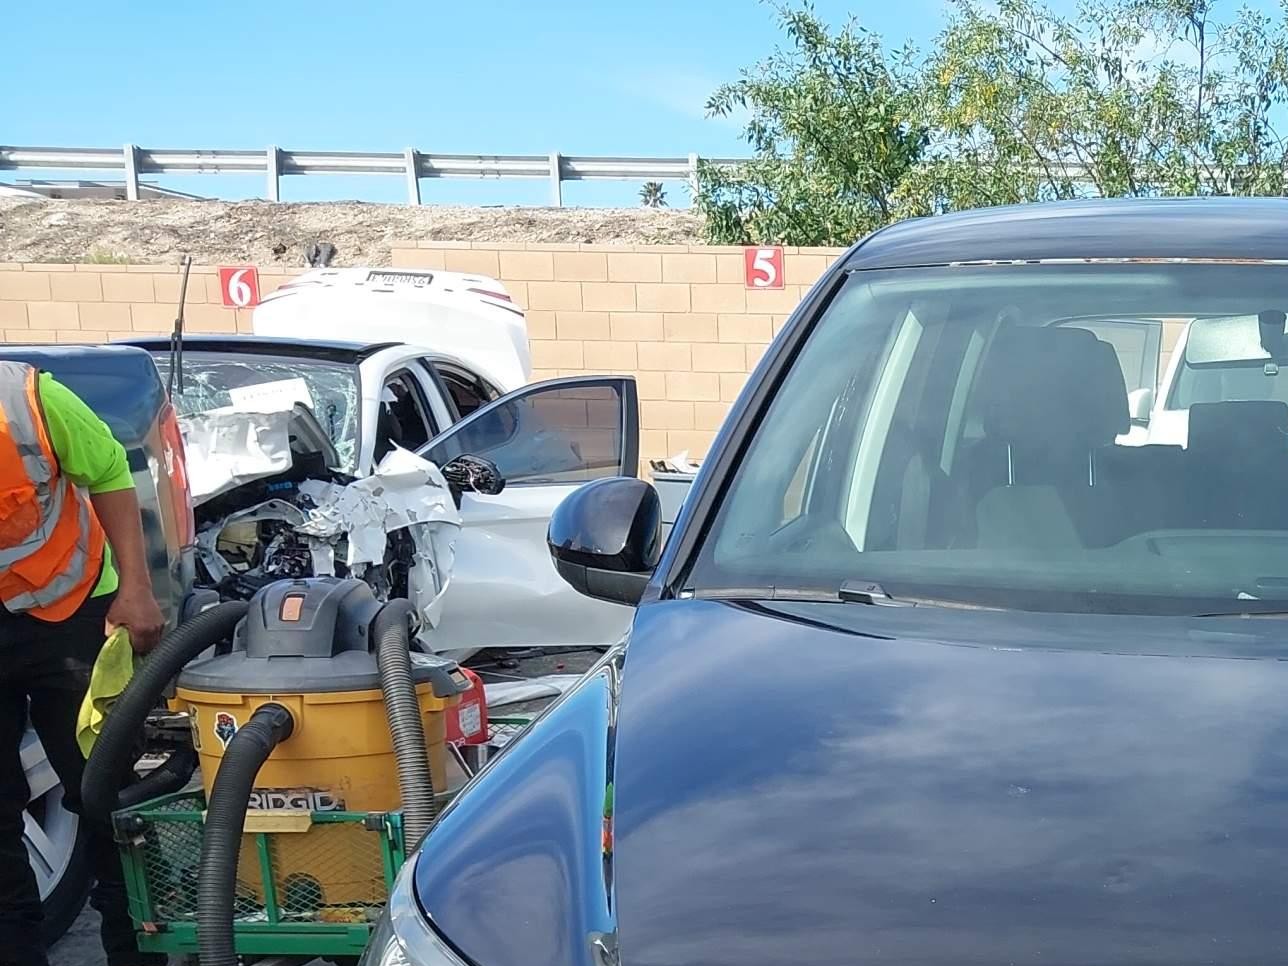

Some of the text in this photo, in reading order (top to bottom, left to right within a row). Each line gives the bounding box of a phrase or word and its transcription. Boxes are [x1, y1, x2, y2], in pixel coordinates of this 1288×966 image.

[752, 249, 777, 287] 5
[228, 269, 252, 307] 6
[248, 791, 338, 812] RIDGID
